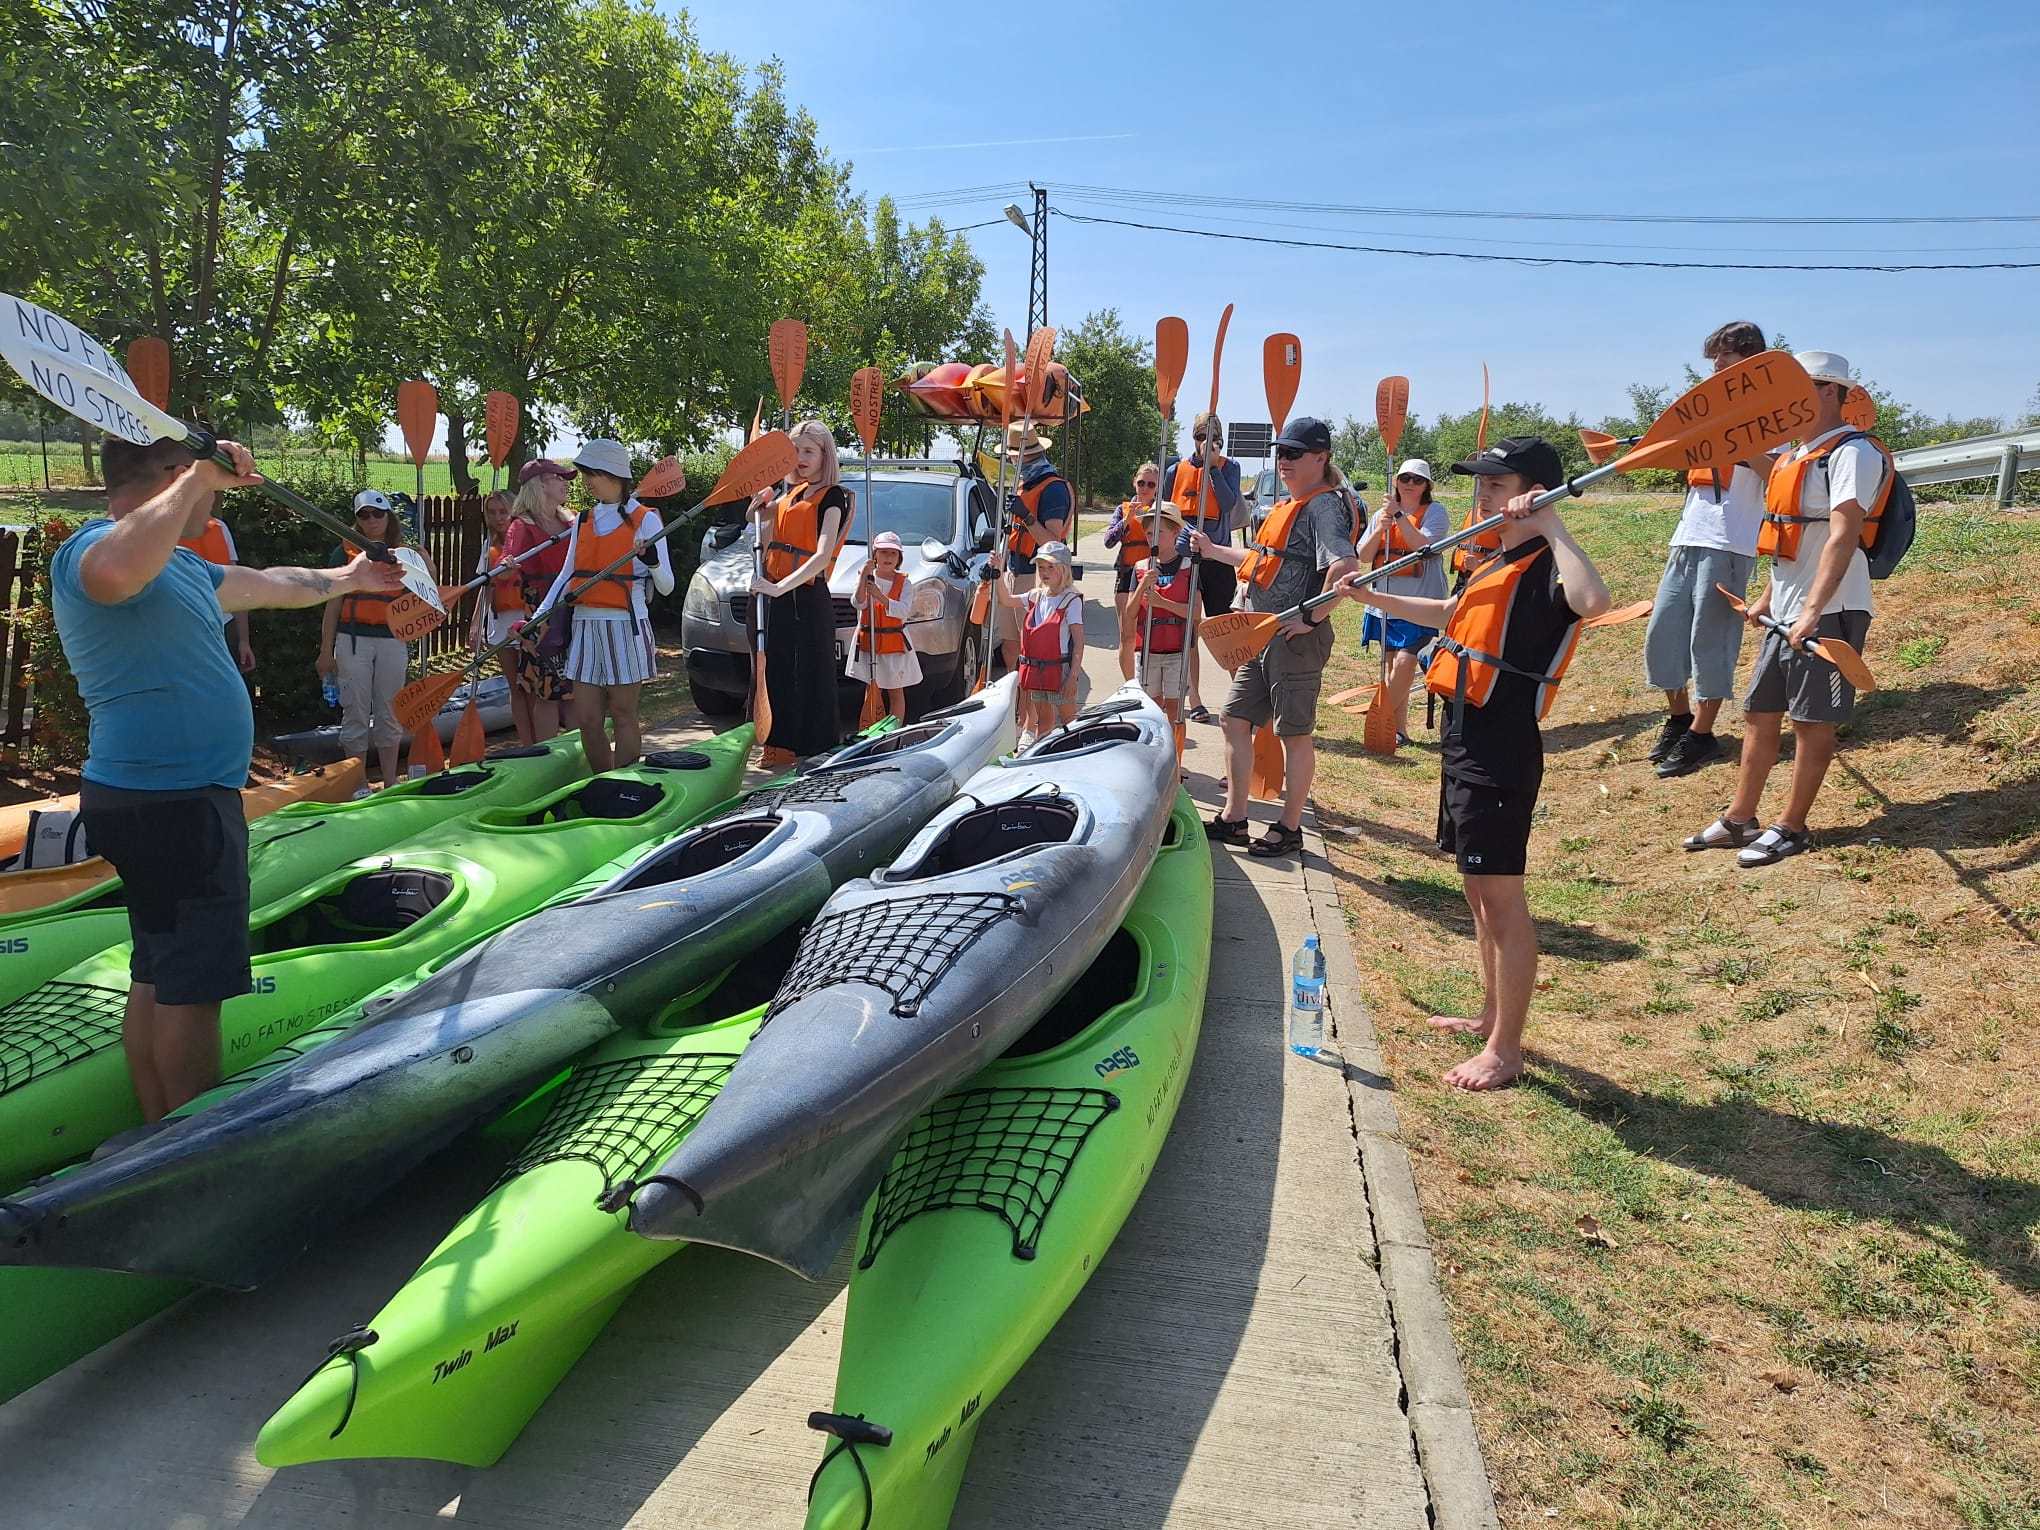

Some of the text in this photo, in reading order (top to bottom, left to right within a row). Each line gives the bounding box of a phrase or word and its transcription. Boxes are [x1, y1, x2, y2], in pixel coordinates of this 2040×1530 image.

[14, 299, 70, 353] NO
[30, 359, 76, 407] NO
[853, 377, 863, 416] NO FAT
[1675, 360, 1777, 426] NO FAT
[869, 410, 879, 427] NO
[1684, 397, 1817, 468] NO STRESS
[653, 485, 667, 497] NO
[735, 481, 753, 498] NO
[391, 599, 410, 616] NO
[395, 623, 415, 639] NO
[230, 1031, 251, 1053] NO
[258, 1018, 287, 1041] FAT
[285, 1014, 304, 1032] NO
[432, 1320, 510, 1385] Twin Max
